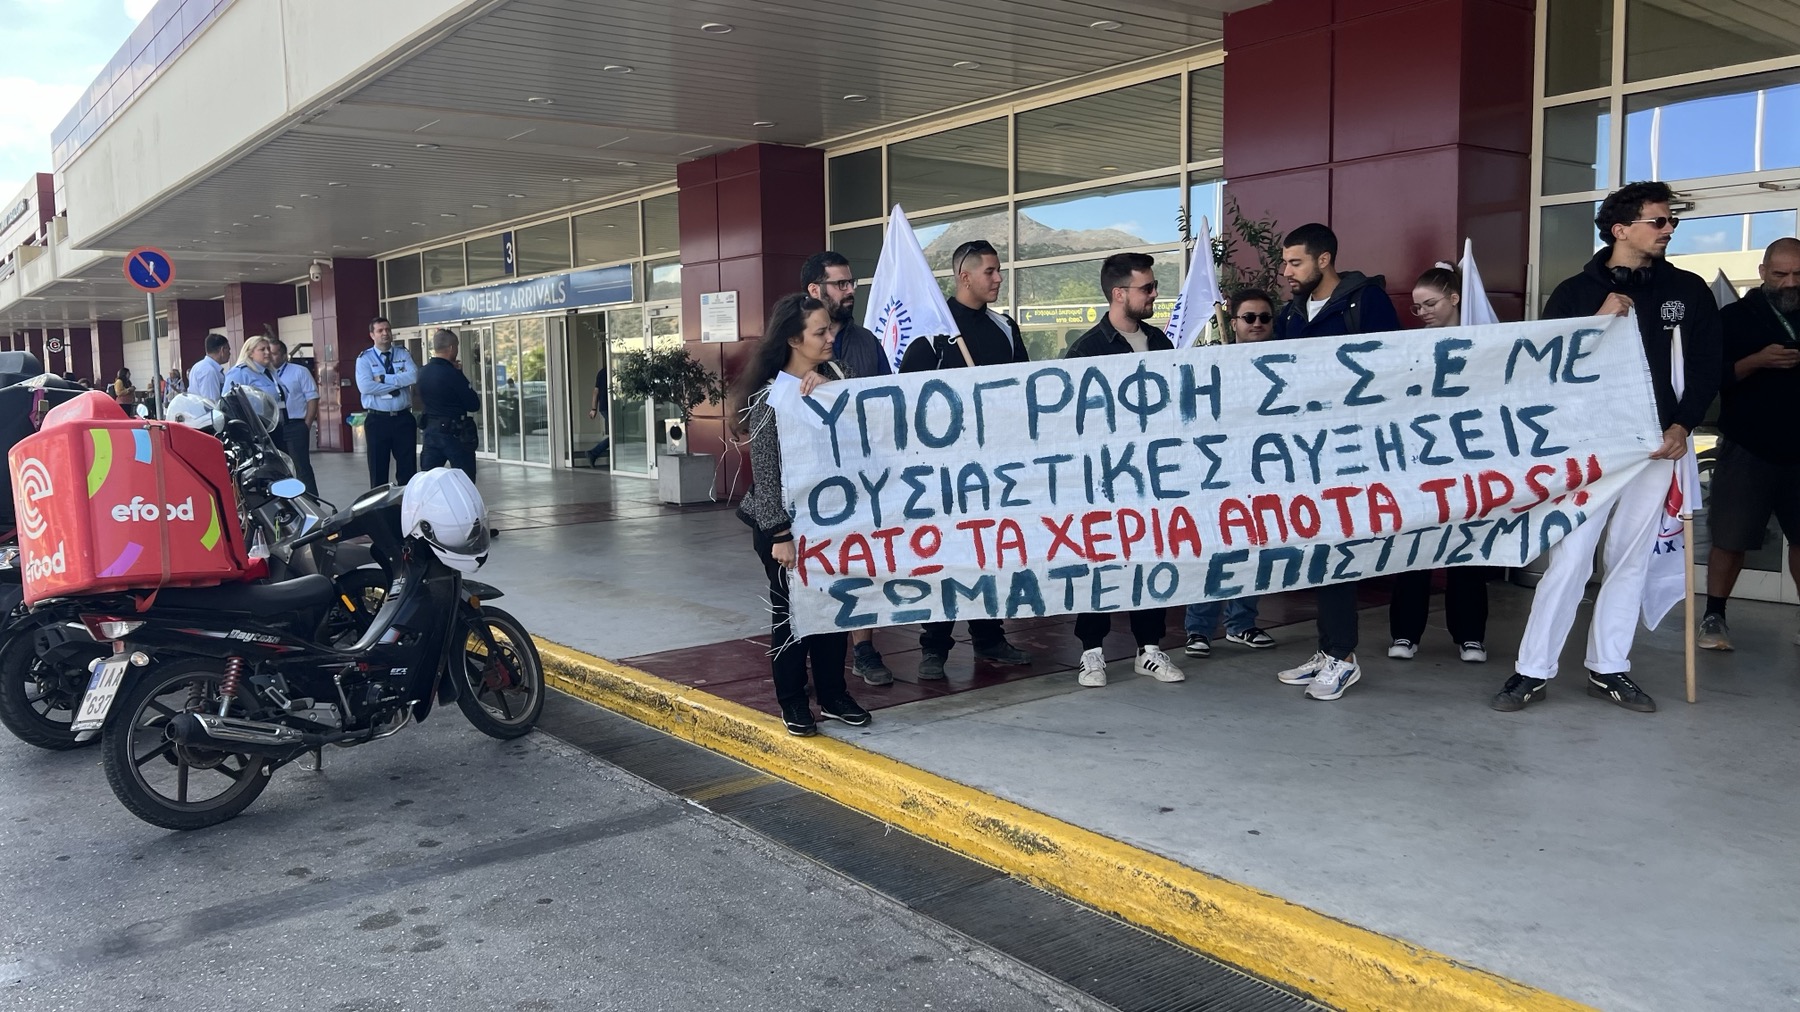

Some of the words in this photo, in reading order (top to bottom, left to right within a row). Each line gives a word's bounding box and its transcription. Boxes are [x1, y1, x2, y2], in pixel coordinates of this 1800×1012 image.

[506, 242, 513, 264] 3
[461, 290, 502, 315] ΑΦΙΞΕΙΣ
[510, 280, 566, 309] ARRIVALS
[802, 360, 1221, 467] ΥΠΟΓΡΑΦΗ
[1505, 328, 1605, 385] ΜΕ
[808, 434, 1231, 527] ΟΥΣΙΑΣΤΙΚΕΣ
[1251, 404, 1570, 484] ΑΥΞΗΣΕΙΣ
[25, 540, 66, 584] efood
[797, 525, 944, 587] ΚΑΤΩ
[956, 518, 1027, 570] ΤΑ
[1041, 506, 1202, 562] ΧΕΡΙΑ
[828, 562, 1179, 627] ΣΩΜΑΤΕΙΟ
[1204, 510, 1587, 598] ΕΠΙΣΙΤΙΣΜΟ
[87, 694, 114, 715] 637
